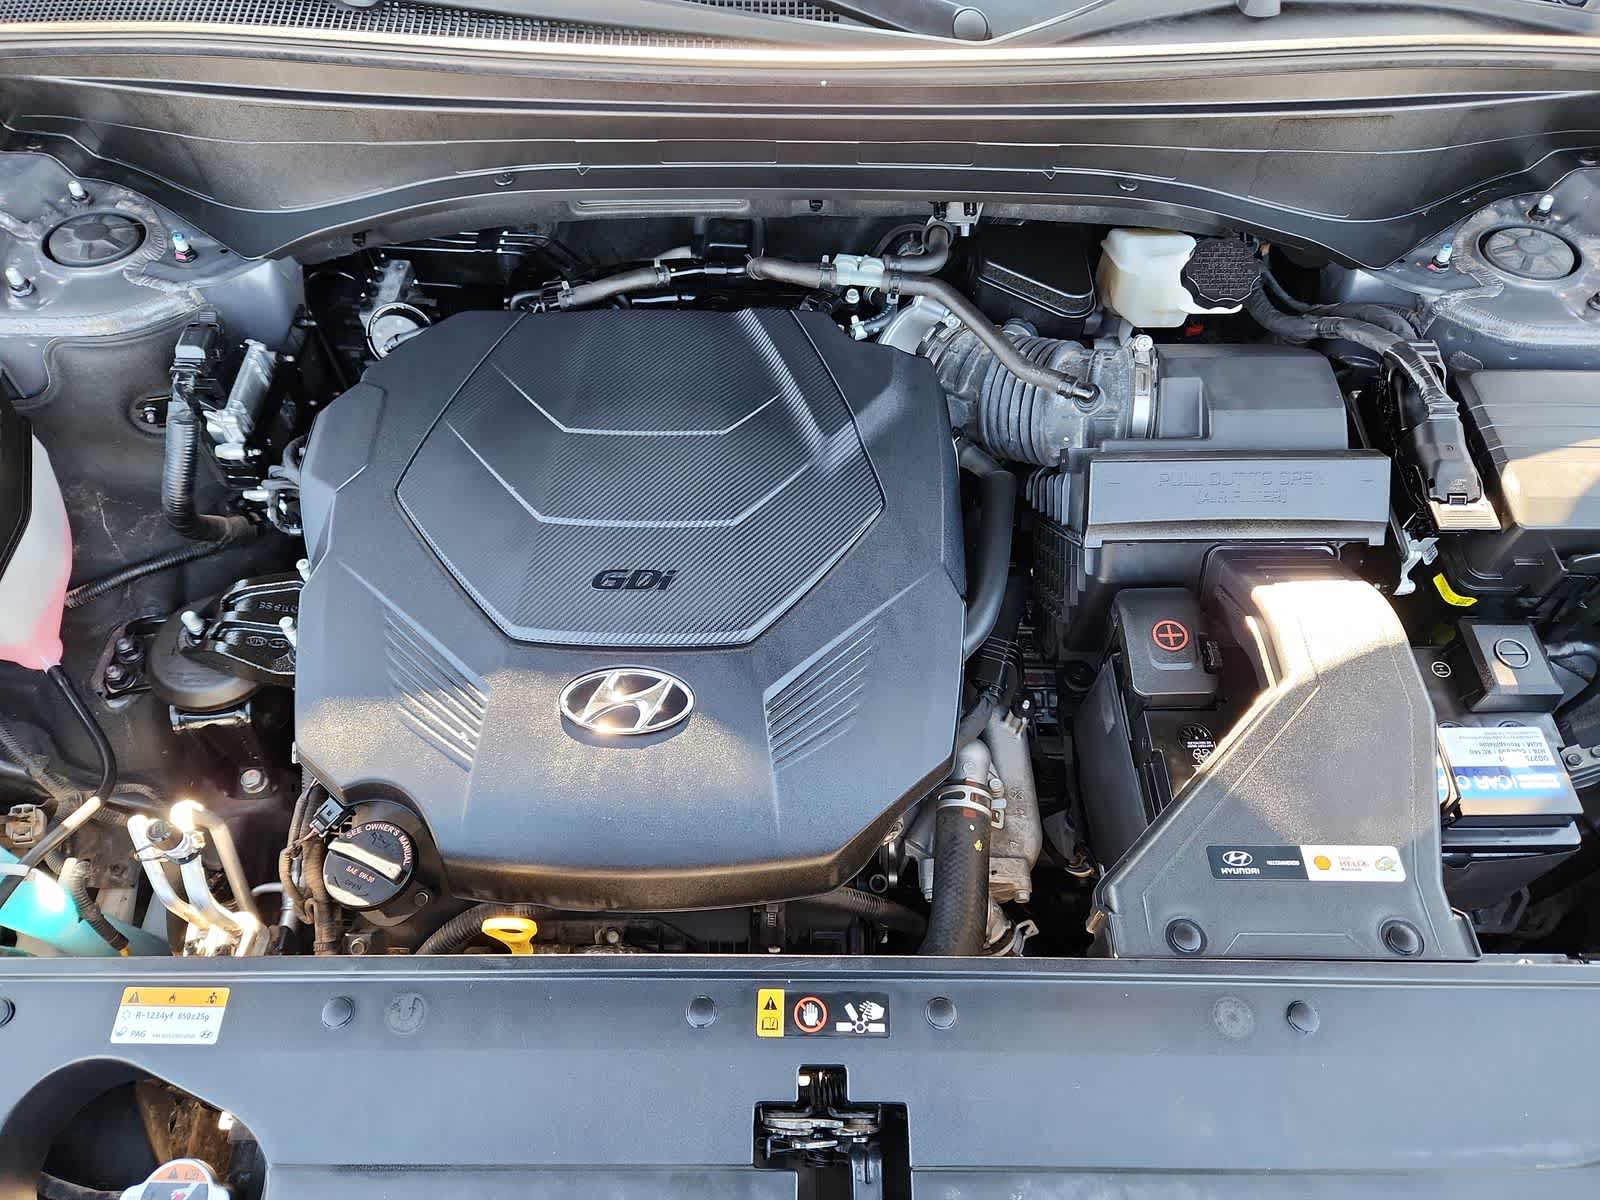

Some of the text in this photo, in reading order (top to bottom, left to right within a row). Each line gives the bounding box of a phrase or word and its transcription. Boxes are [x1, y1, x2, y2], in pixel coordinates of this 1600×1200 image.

[1157, 472, 1201, 487] PULL
[592, 569, 677, 591] GDi
[345, 823, 413, 866] SEE OWNER'S MANUAL
[345, 865, 358, 875] SAE
[1220, 867, 1261, 875] HYUNDAI
[129, 1030, 147, 1038] PAG
